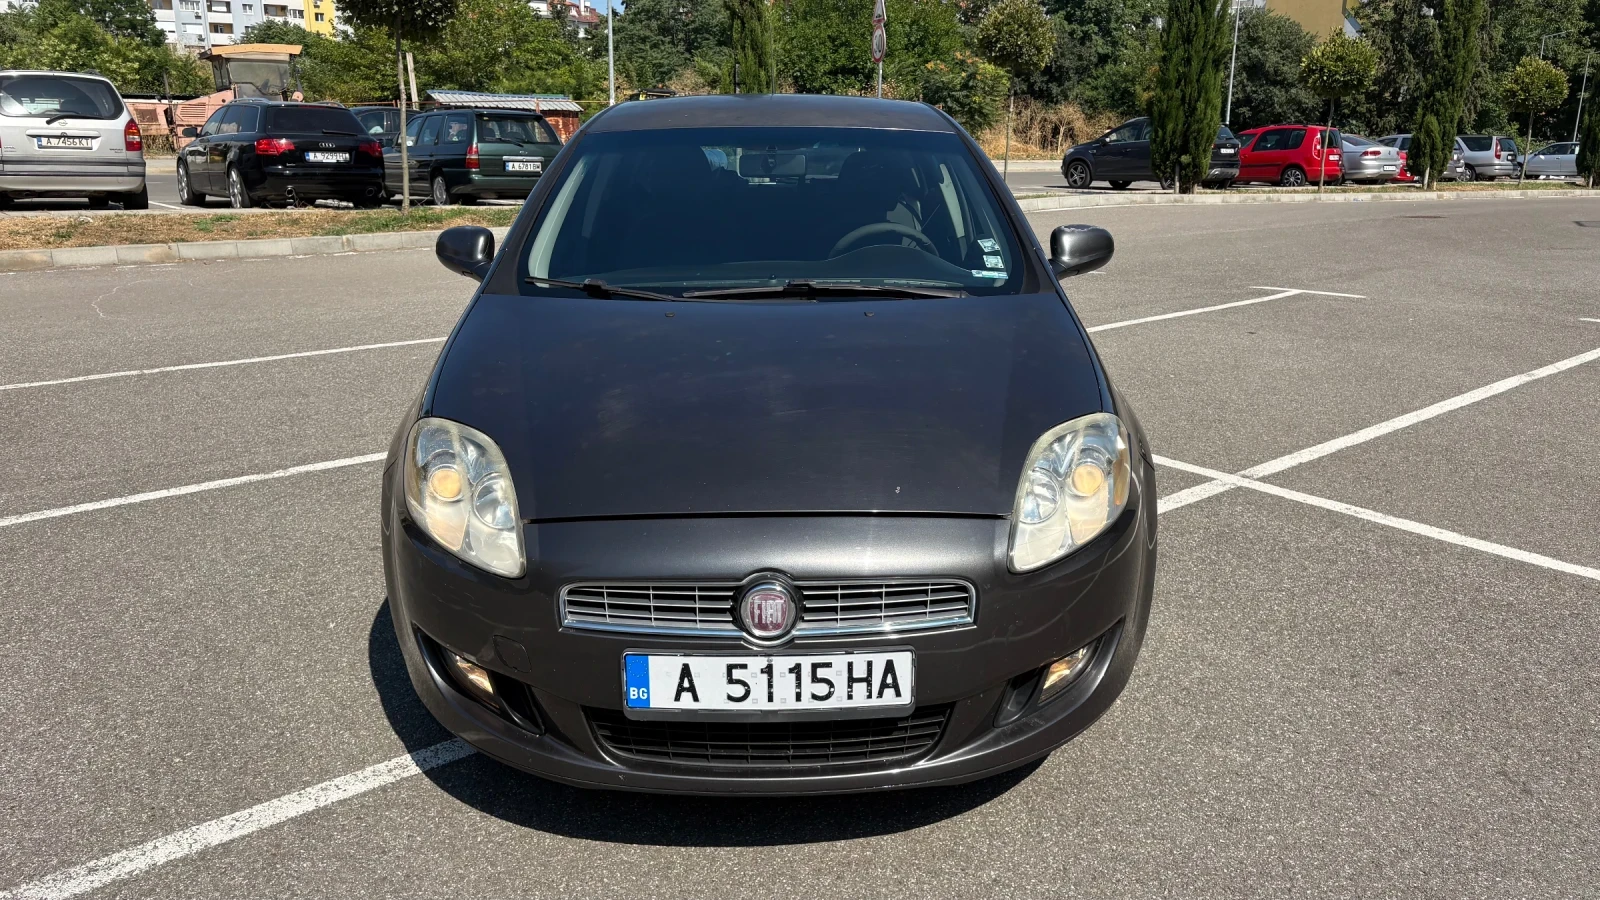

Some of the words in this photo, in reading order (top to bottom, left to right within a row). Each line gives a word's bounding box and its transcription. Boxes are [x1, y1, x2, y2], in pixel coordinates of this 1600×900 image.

[753, 600, 785, 624] FIAT
[630, 687, 648, 699] BG
[674, 663, 700, 702] A
